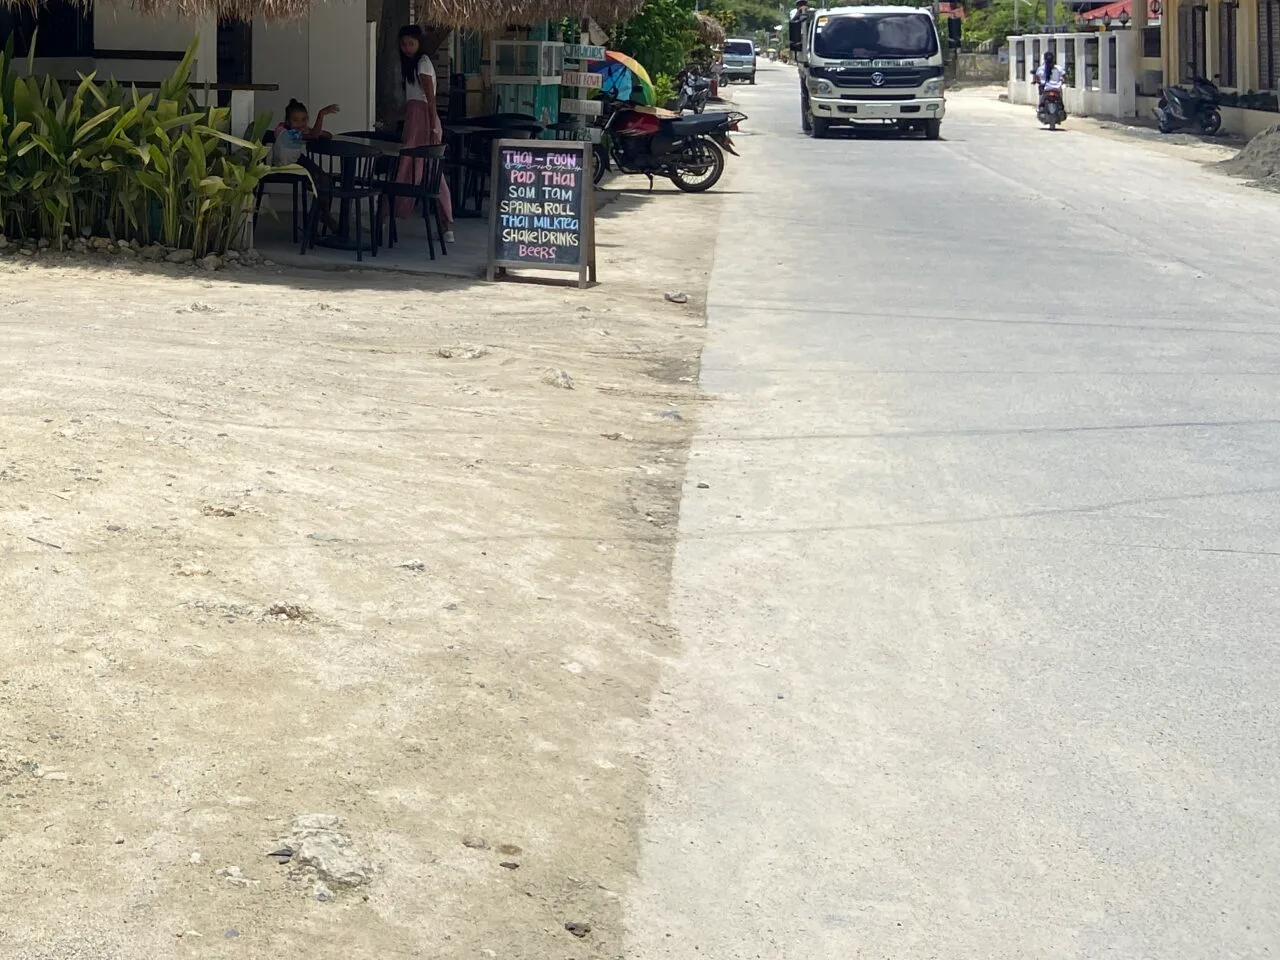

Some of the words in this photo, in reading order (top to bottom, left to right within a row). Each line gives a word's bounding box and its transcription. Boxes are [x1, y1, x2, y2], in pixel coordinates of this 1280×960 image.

[547, 153, 576, 167] FOON
[500, 200, 541, 214] SPRING
[544, 202, 575, 215] ROLL
